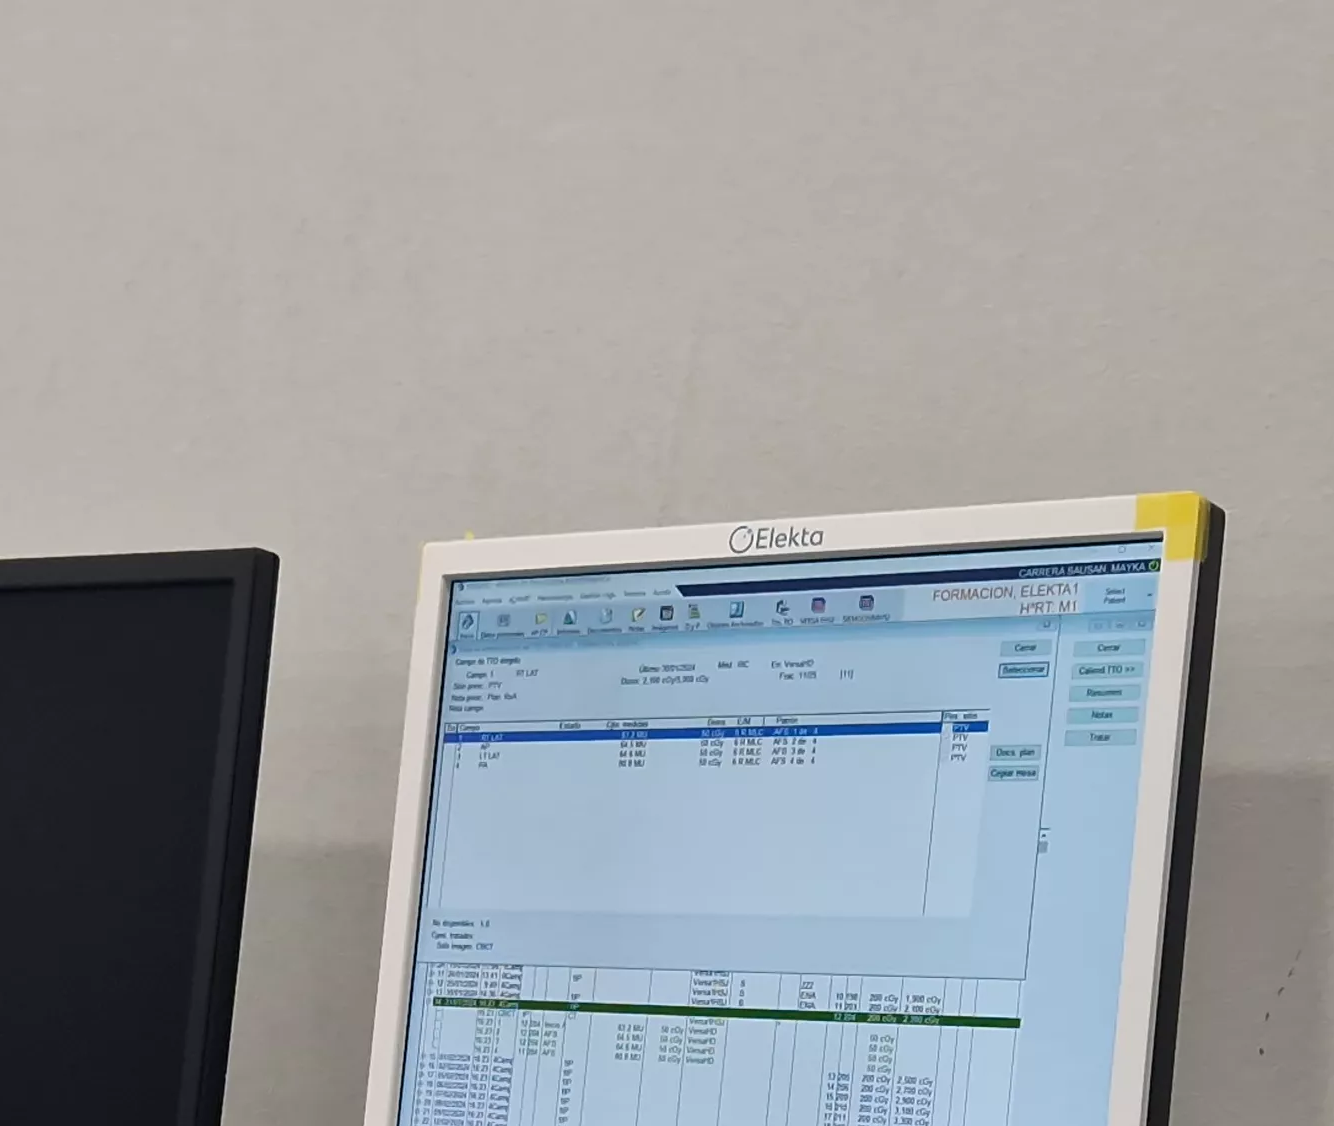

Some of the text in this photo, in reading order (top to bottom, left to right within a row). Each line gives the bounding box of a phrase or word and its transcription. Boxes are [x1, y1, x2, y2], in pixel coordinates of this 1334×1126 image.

[756, 526, 824, 549] Elekta
[932, 582, 1079, 602] FORMACION, ELEKTA1
